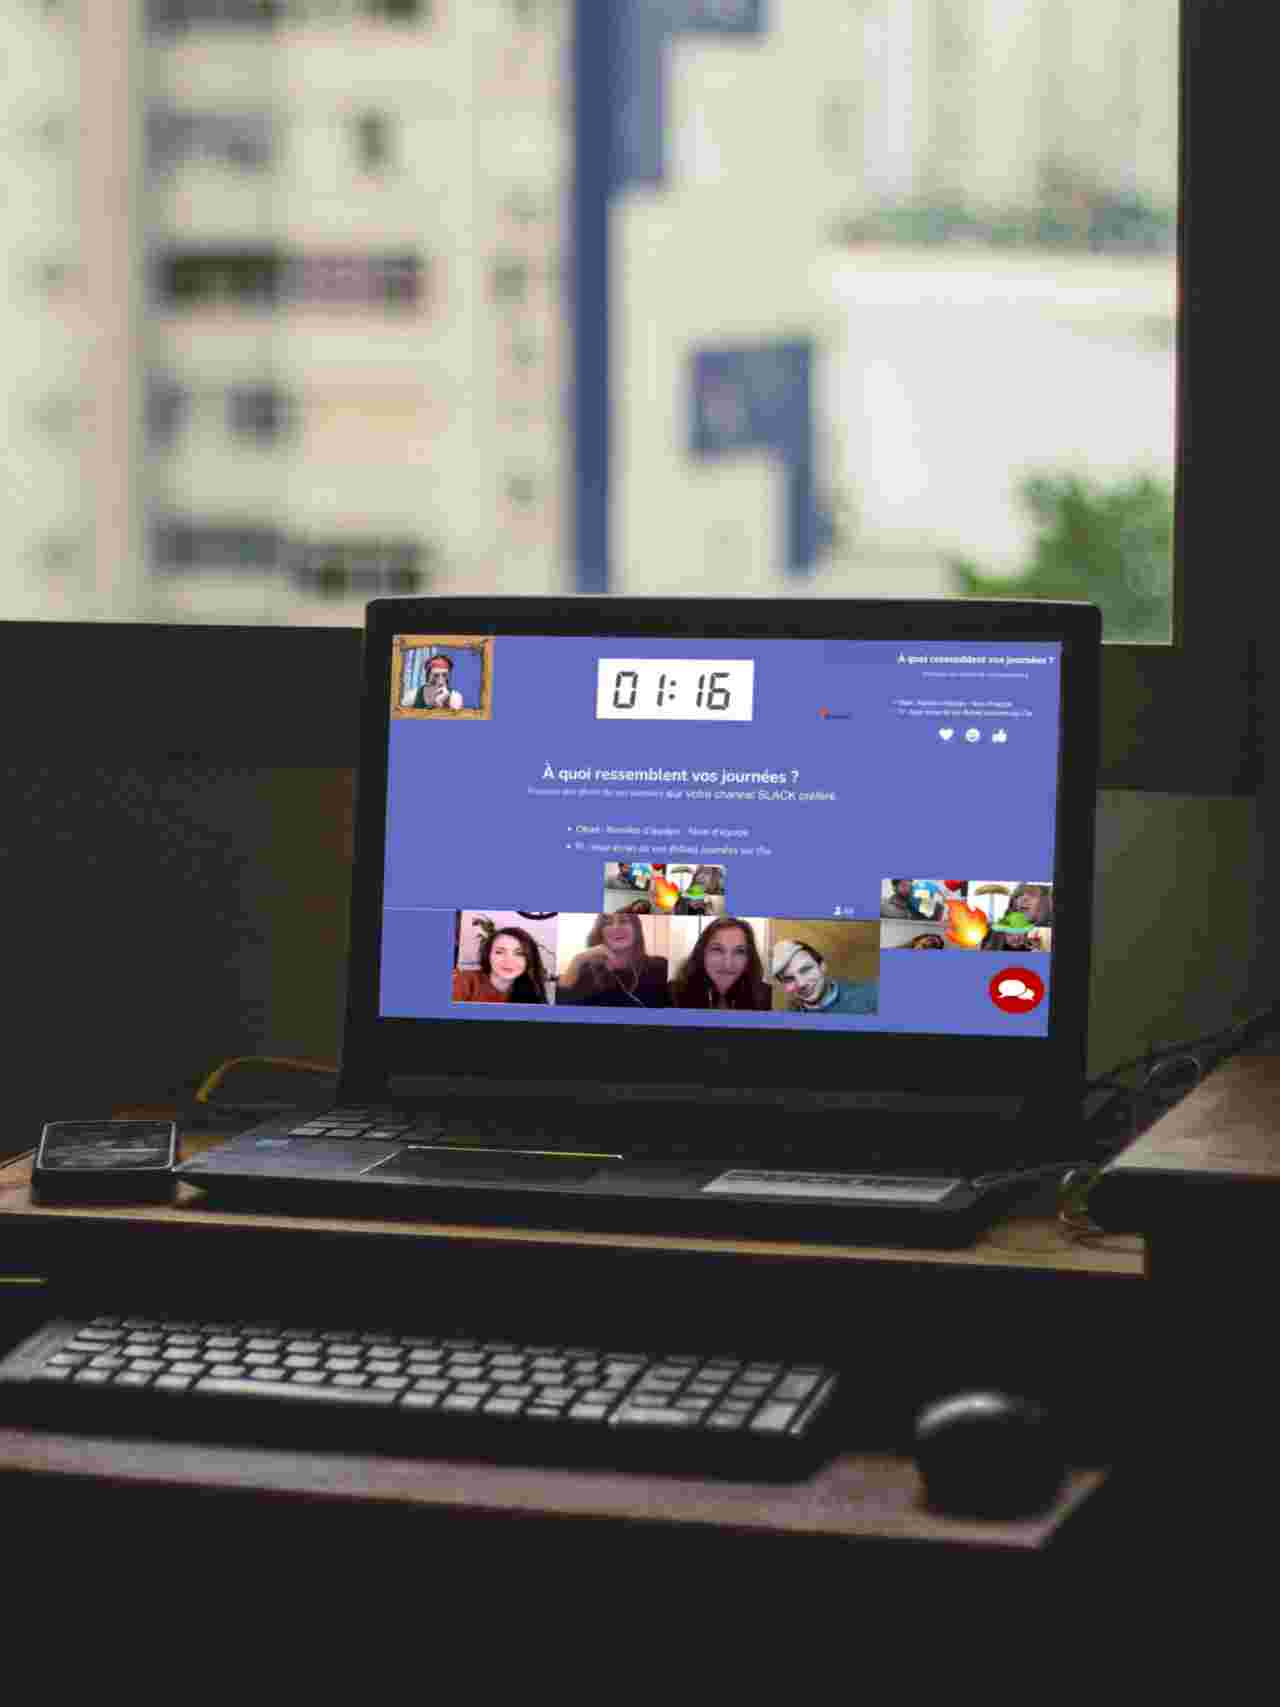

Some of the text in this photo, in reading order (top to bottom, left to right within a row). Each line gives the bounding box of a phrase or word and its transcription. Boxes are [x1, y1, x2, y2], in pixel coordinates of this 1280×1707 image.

[613, 671, 731, 710] 01:16
[542, 760, 555, 779] À
[558, 767, 592, 783] quoi
[595, 767, 689, 782] ressemblent
[692, 771, 718, 783] vos
[720, 768, 787, 785] journées
[758, 790, 796, 801] SLACK
